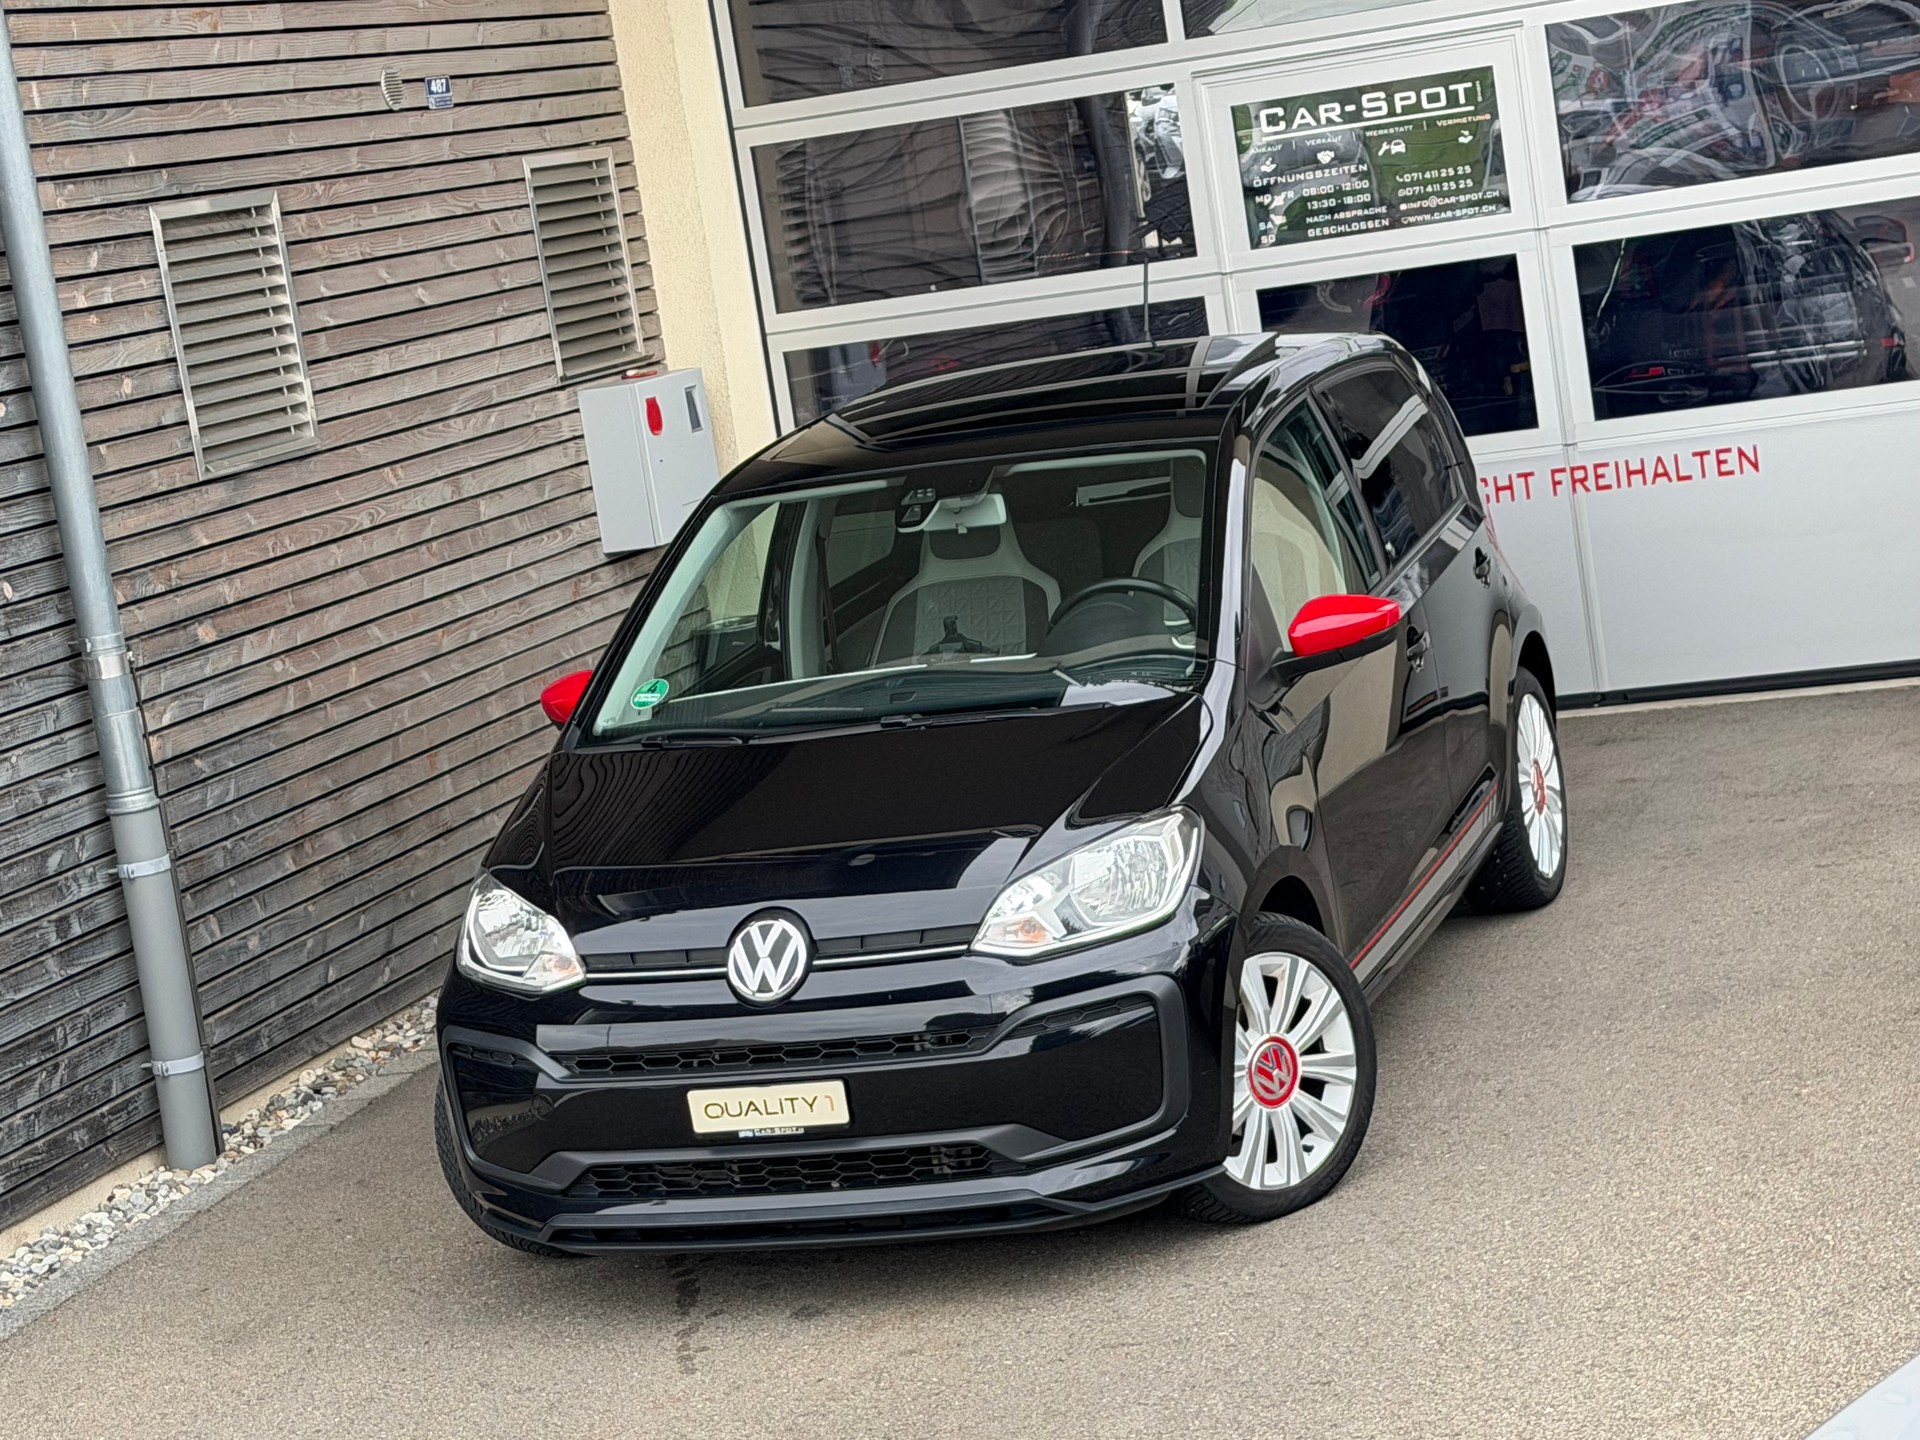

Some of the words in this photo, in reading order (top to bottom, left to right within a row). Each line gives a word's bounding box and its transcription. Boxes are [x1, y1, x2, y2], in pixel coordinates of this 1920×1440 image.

[430, 78, 446, 93] 487
[1259, 82, 1473, 134] CAR-SPOT
[1305, 135, 1343, 146] VERKAUF
[1365, 125, 1414, 137] WERKSTATT
[1253, 163, 1368, 188] ÖFFNUNGSZEITEN
[1341, 180, 1370, 191] 12:00
[1403, 172, 1422, 182] 071
[1424, 169, 1439, 179] 411
[1405, 185, 1424, 196] 071
[1425, 183, 1440, 193] 411
[1307, 198, 1337, 210] 13:30
[1259, 220, 1274, 231] SA
[1306, 214, 1332, 224] NACH
[1333, 206, 1388, 220] ABSPRACHE
[1260, 233, 1276, 244] SO
[1307, 218, 1390, 237] GESCHLOSSEN
[1550, 443, 1760, 497] FREIHALTEN
[730, 919, 803, 998] VW
[704, 1096, 818, 1119] QUALITY
